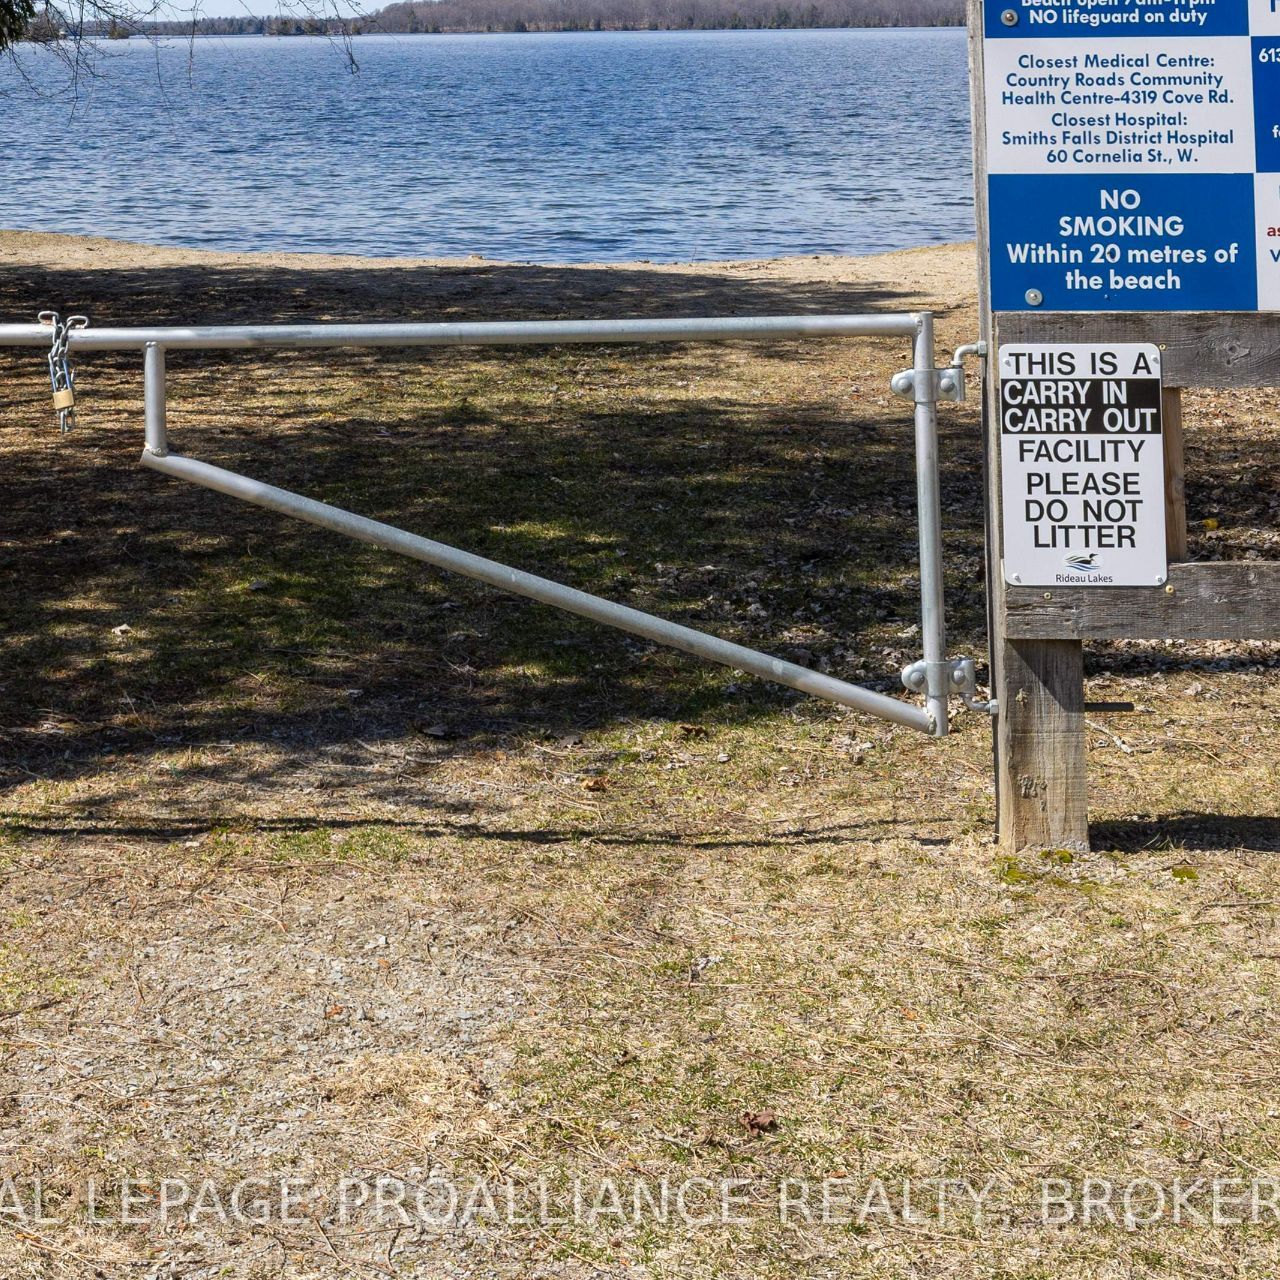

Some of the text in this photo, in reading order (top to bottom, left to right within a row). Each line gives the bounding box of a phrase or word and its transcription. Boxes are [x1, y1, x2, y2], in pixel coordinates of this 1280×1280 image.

[1018, 54, 1214, 68] Closest Medical Centre:
[1007, 72, 1223, 90] Country Roads Community
[1002, 89, 1233, 104] Health Centre-4319 Cove Rd.
[1052, 112, 1187, 129] Closest Hospital:
[1101, 190, 1140, 209] NO
[1060, 216, 1184, 236] SMOKING
[1007, 243, 1238, 263] Within 20 metres of
[1066, 269, 1180, 289] the beach
[1009, 352, 1152, 375] THIS IS A
[1003, 380, 1127, 405] CARRY IN
[1004, 408, 1157, 432] CARRY OUT
[1019, 440, 1145, 462] FACILITY
[1027, 472, 1140, 495] PLEASE
[1026, 499, 1143, 522] DO NOT
[1034, 525, 1136, 548] LITTER
[1056, 574, 1112, 582] Rideau Lakes
